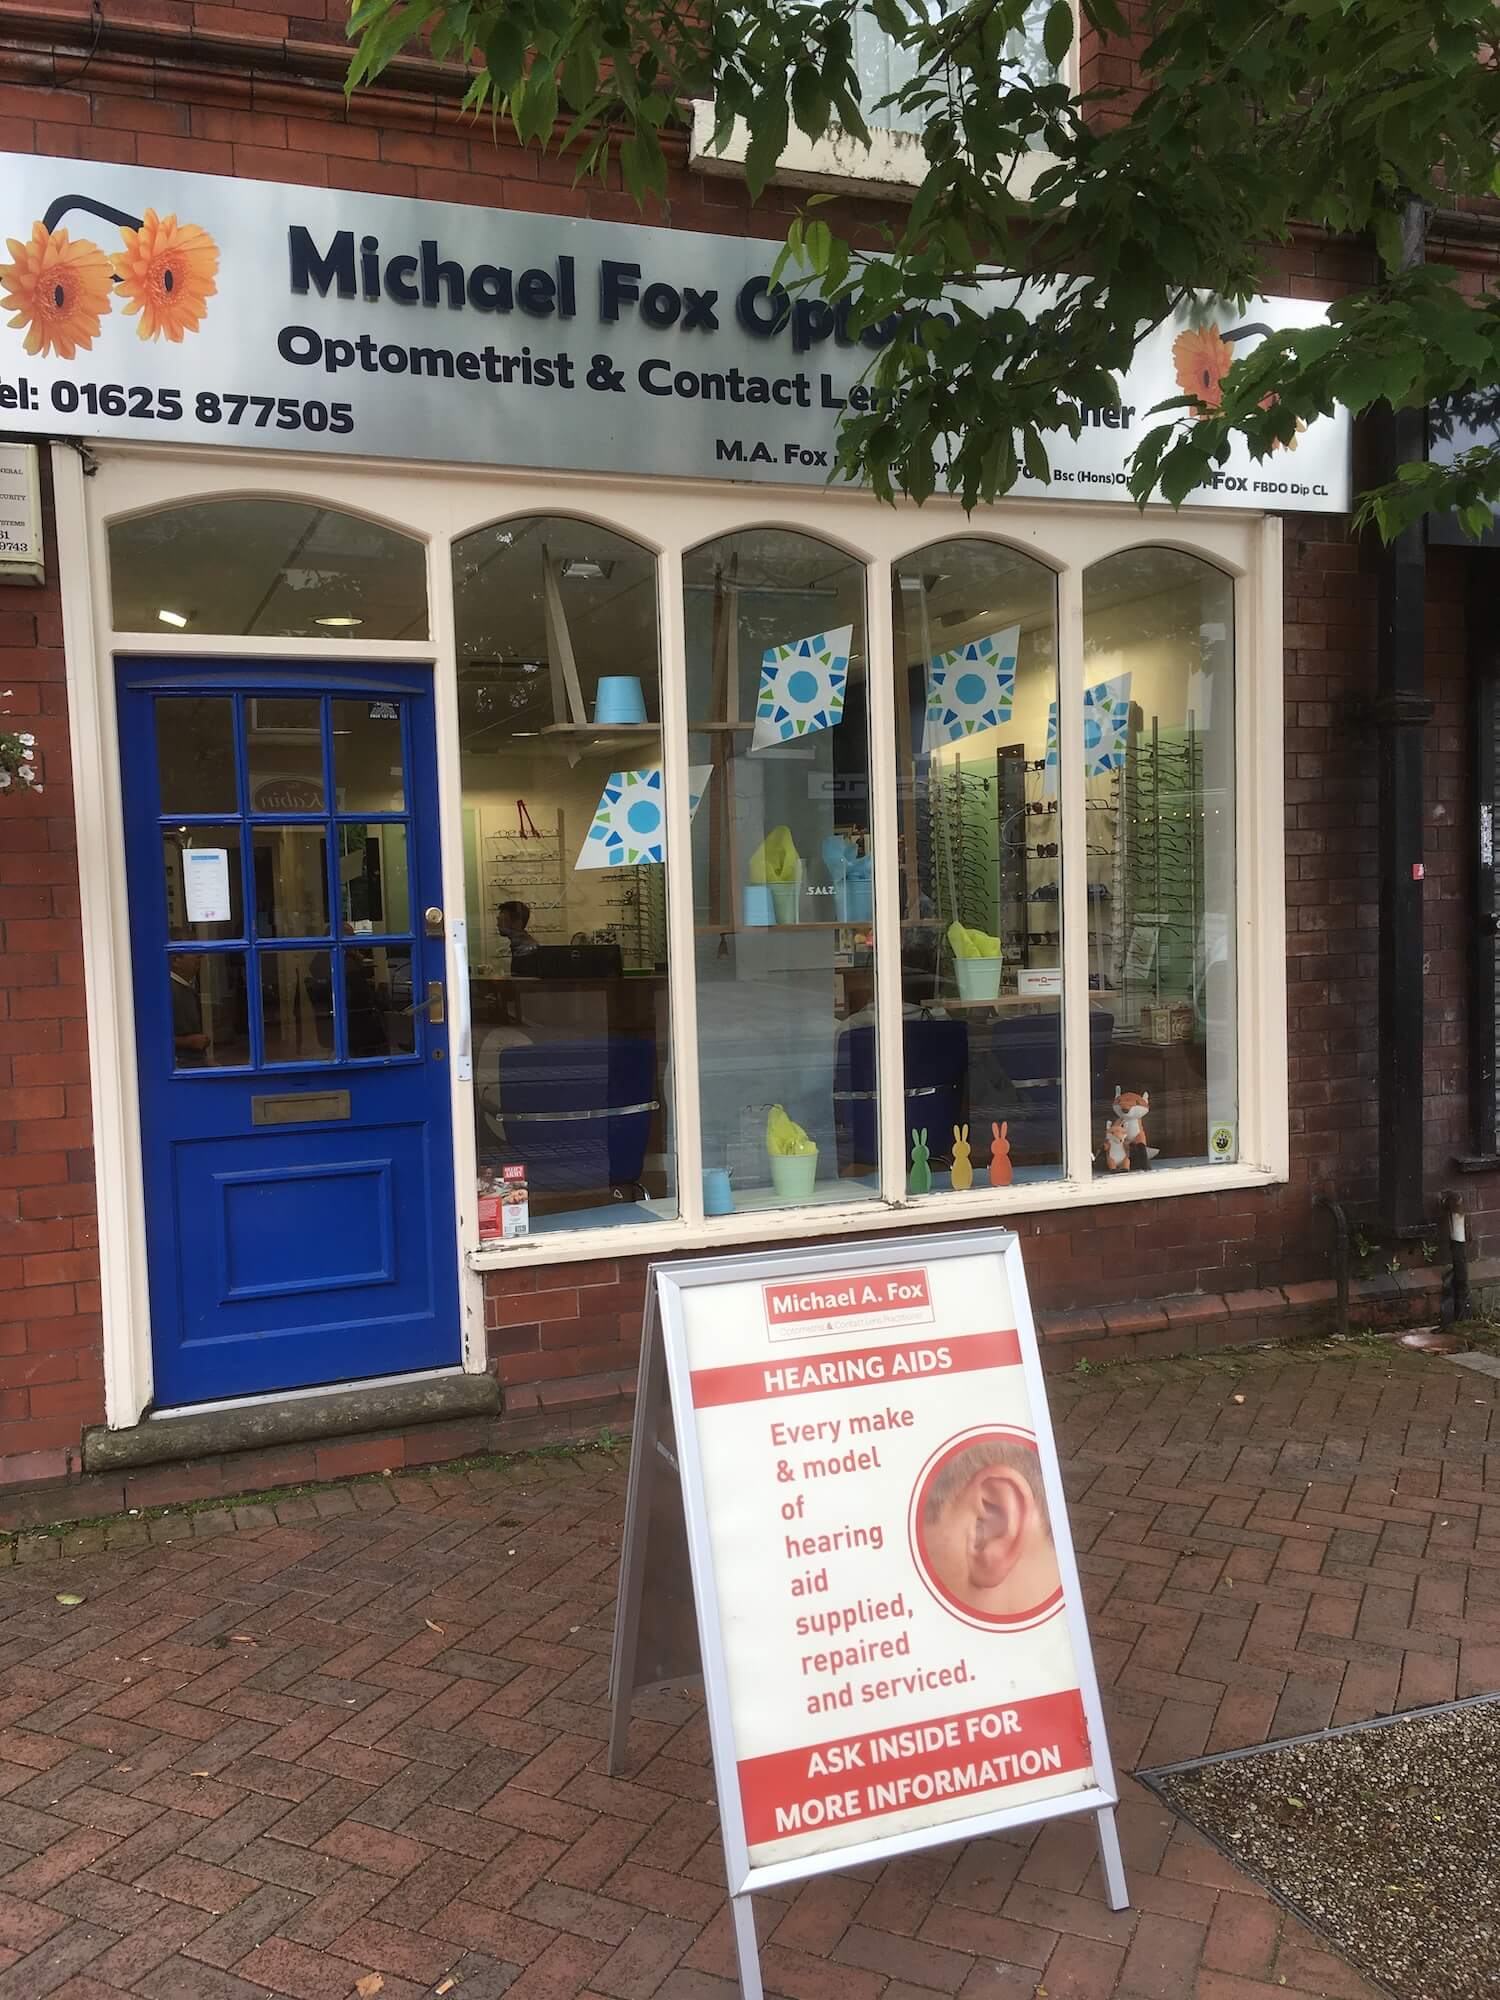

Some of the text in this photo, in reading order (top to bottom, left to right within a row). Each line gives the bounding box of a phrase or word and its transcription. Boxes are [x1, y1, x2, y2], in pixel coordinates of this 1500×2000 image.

[289, 225, 577, 318] Michael
[600, 259, 720, 331] Fox
[277, 325, 576, 389] Optometrist
[586, 354, 626, 393] &
[638, 359, 811, 407] Contact
[0, 377, 355, 433] el: 01625 877505
[715, 439, 778, 463] M.A.
[784, 443, 828, 467] Fox
[1053, 469, 1075, 482] Bsc
[1212, 471, 1248, 492] Fox
[1253, 481, 1288, 494] FBDO
[1291, 483, 1310, 497] Dip
[1312, 484, 1328, 496] CL
[772, 1282, 924, 1315] Michael A. Fox
[763, 1346, 952, 1393] HEARING AIDS
[770, 1407, 914, 1447] Every make
[776, 1446, 881, 1483] & model
[781, 1494, 804, 1521] of
[784, 1523, 884, 1559] hearing
[790, 1568, 829, 1597] aid
[795, 1592, 914, 1638] supplied,
[801, 1631, 910, 1676] repaired
[806, 1659, 976, 1714] and serviced.
[807, 1708, 1021, 1778] ASK INSIDE FOR
[774, 1744, 1062, 1833] MORE INFORMATION
